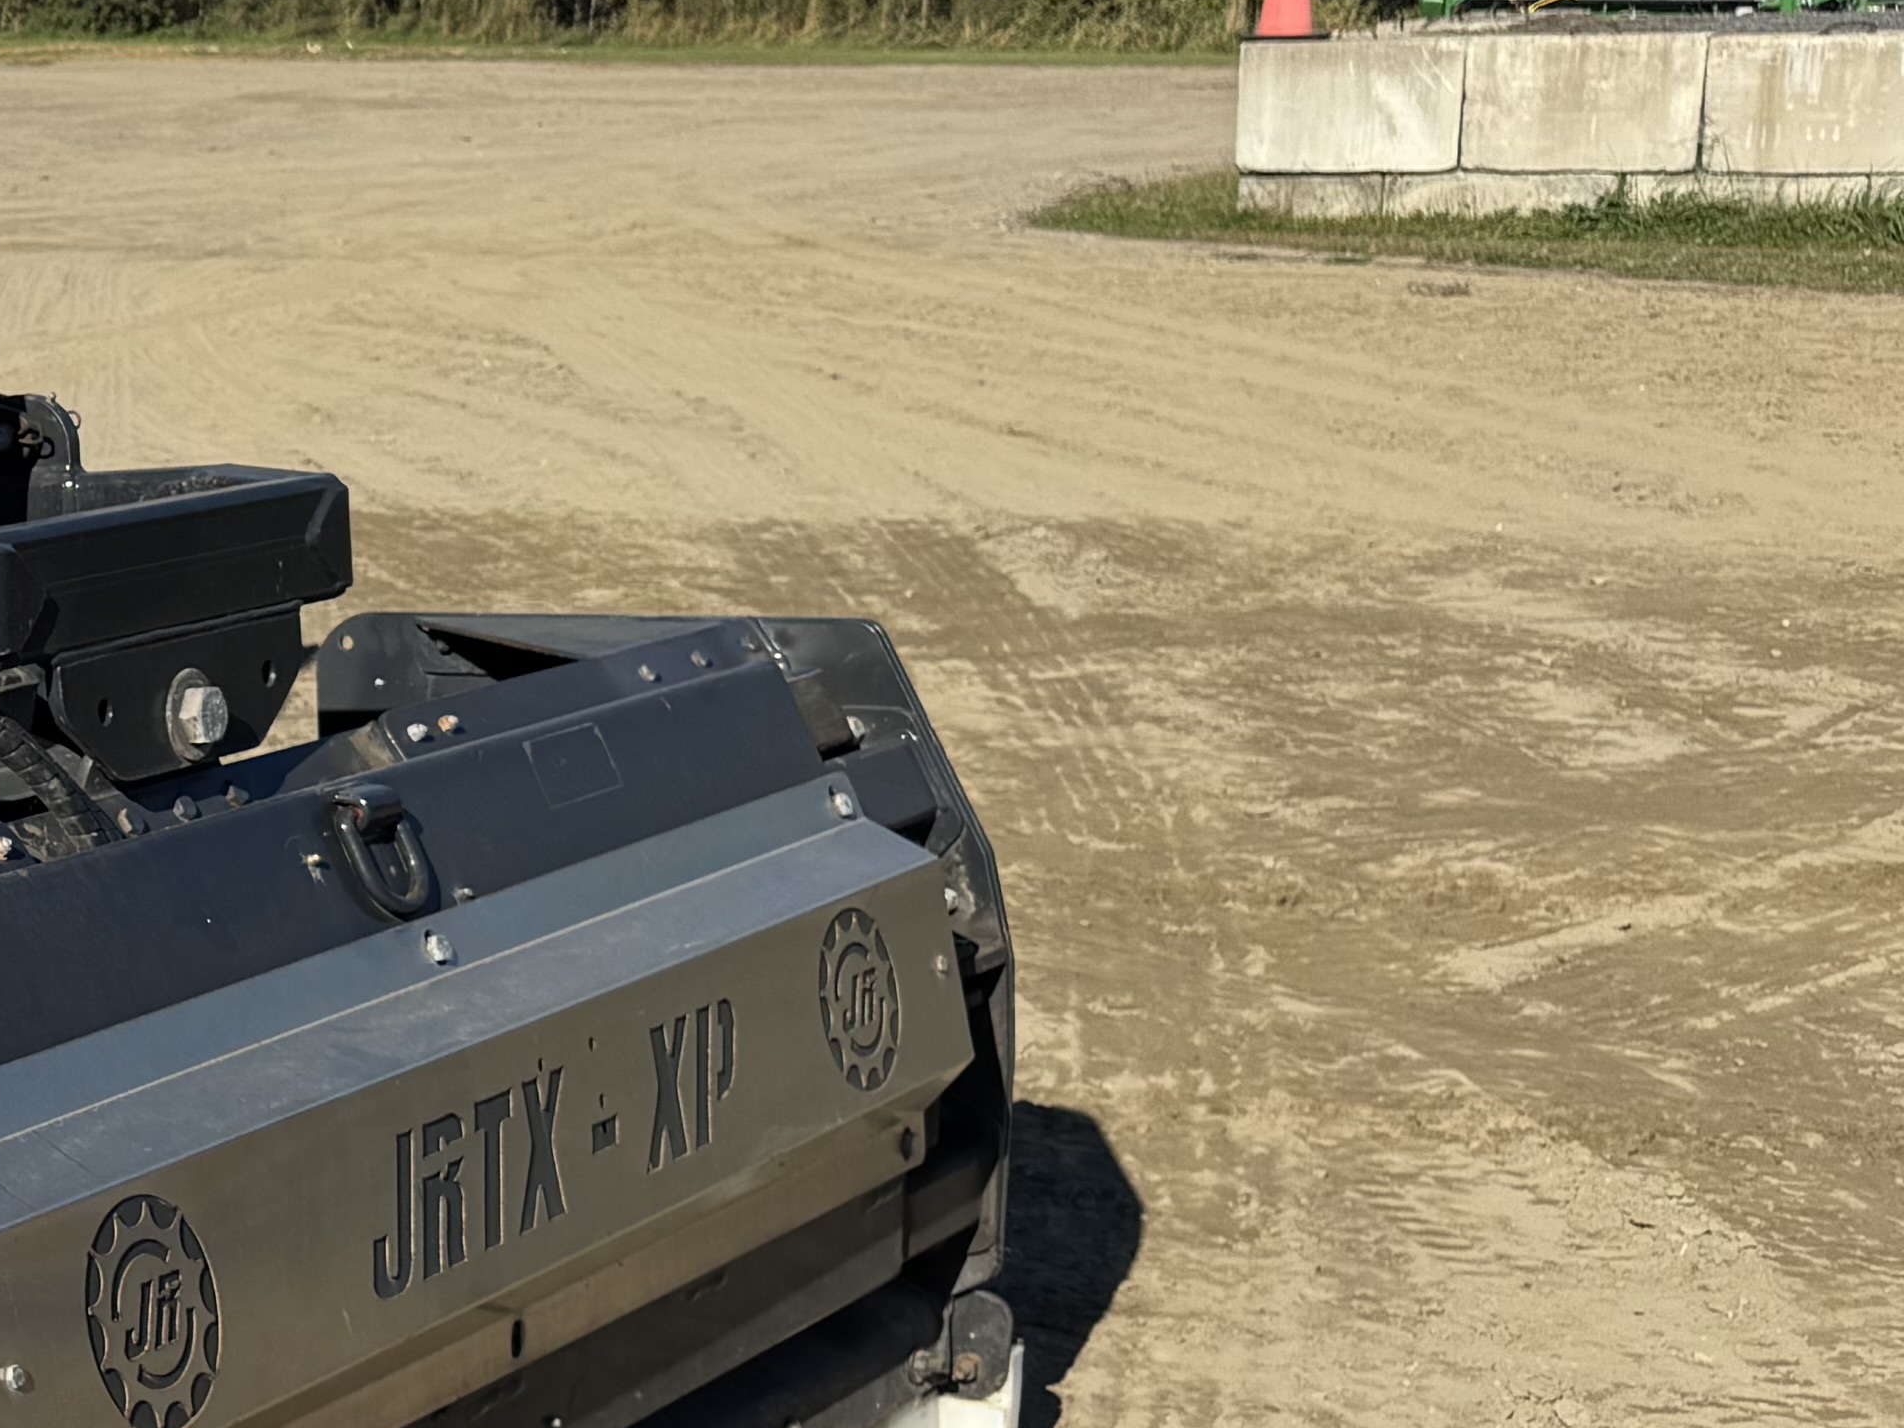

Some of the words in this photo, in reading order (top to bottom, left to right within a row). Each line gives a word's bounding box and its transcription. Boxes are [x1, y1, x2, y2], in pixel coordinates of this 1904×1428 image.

[843, 967, 877, 1033] JR
[373, 1066, 567, 1299] JRTX
[647, 997, 735, 1174] XP
[124, 1269, 183, 1362] JR
